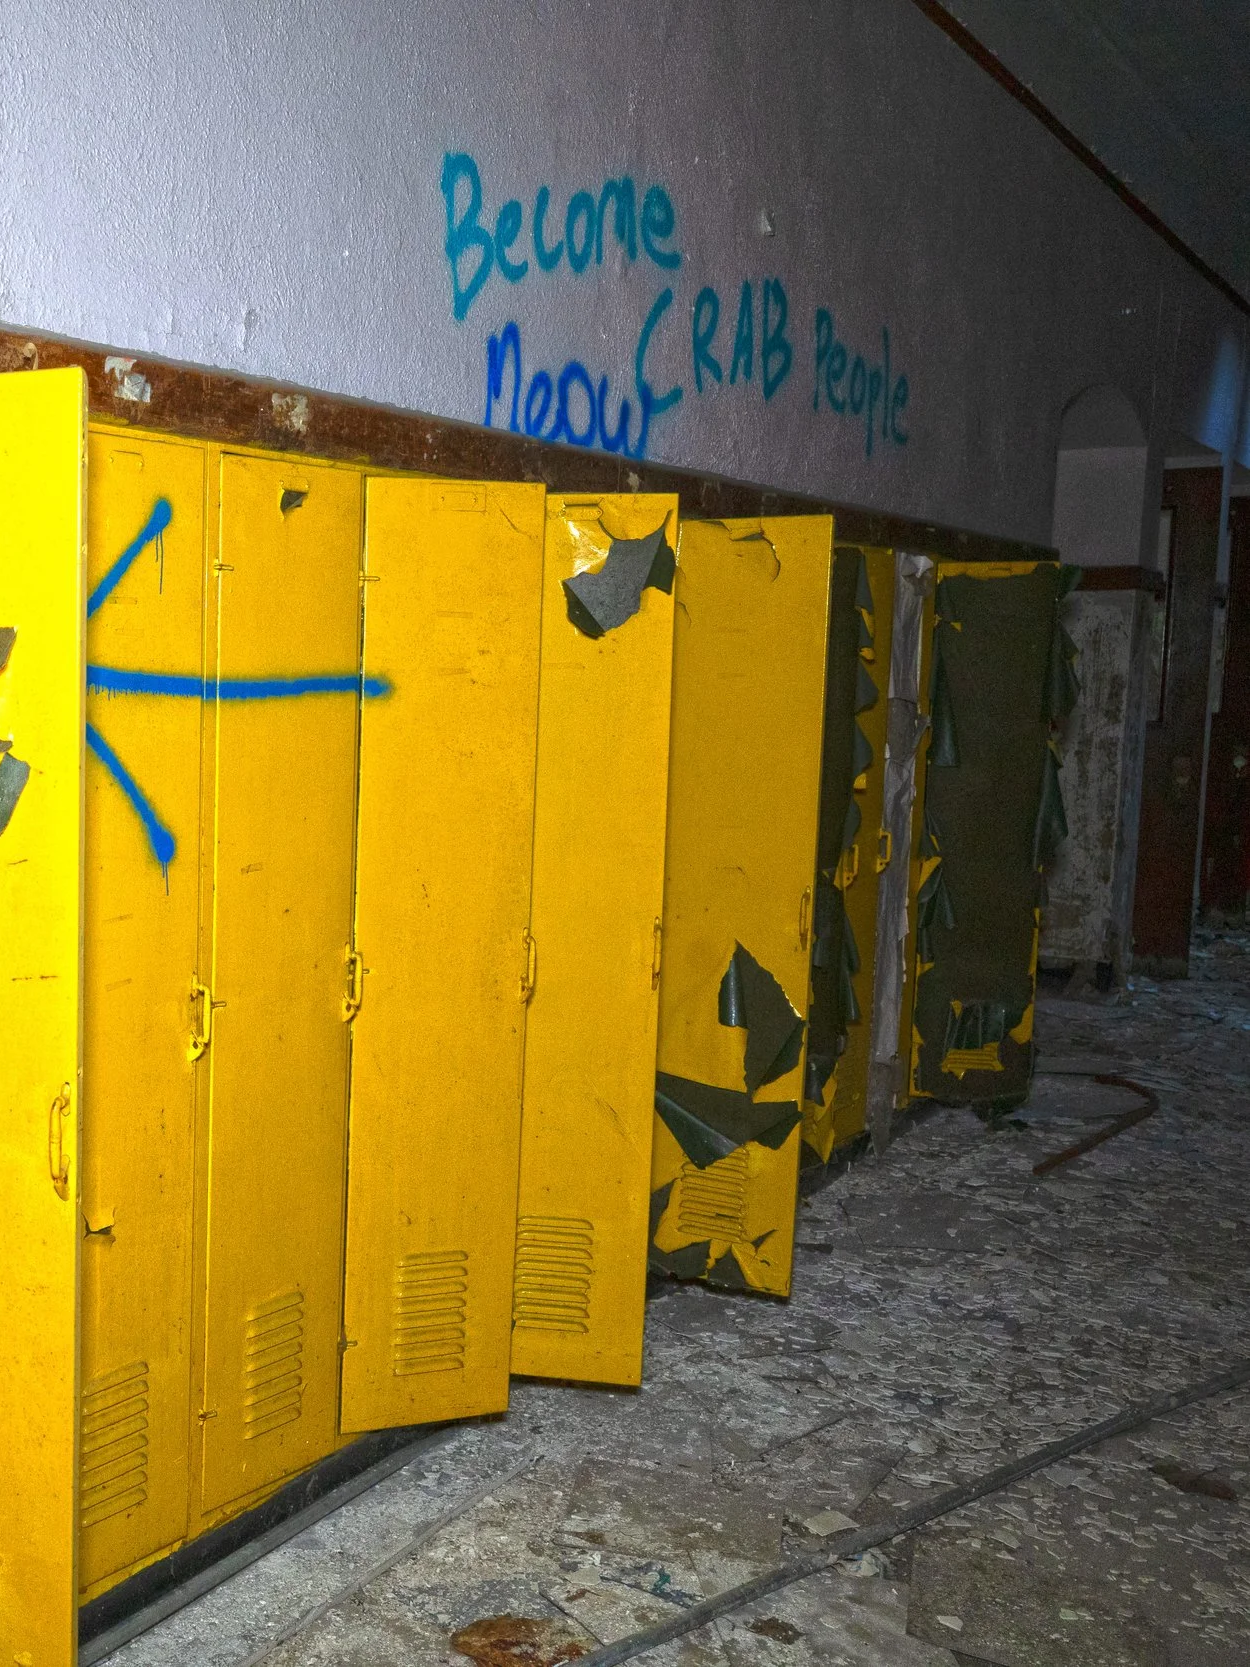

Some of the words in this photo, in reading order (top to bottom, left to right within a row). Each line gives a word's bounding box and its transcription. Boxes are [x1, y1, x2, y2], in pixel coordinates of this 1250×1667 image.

[441, 152, 681, 321] Become
[635, 277, 793, 414] CRAB
[814, 307, 909, 458] People
